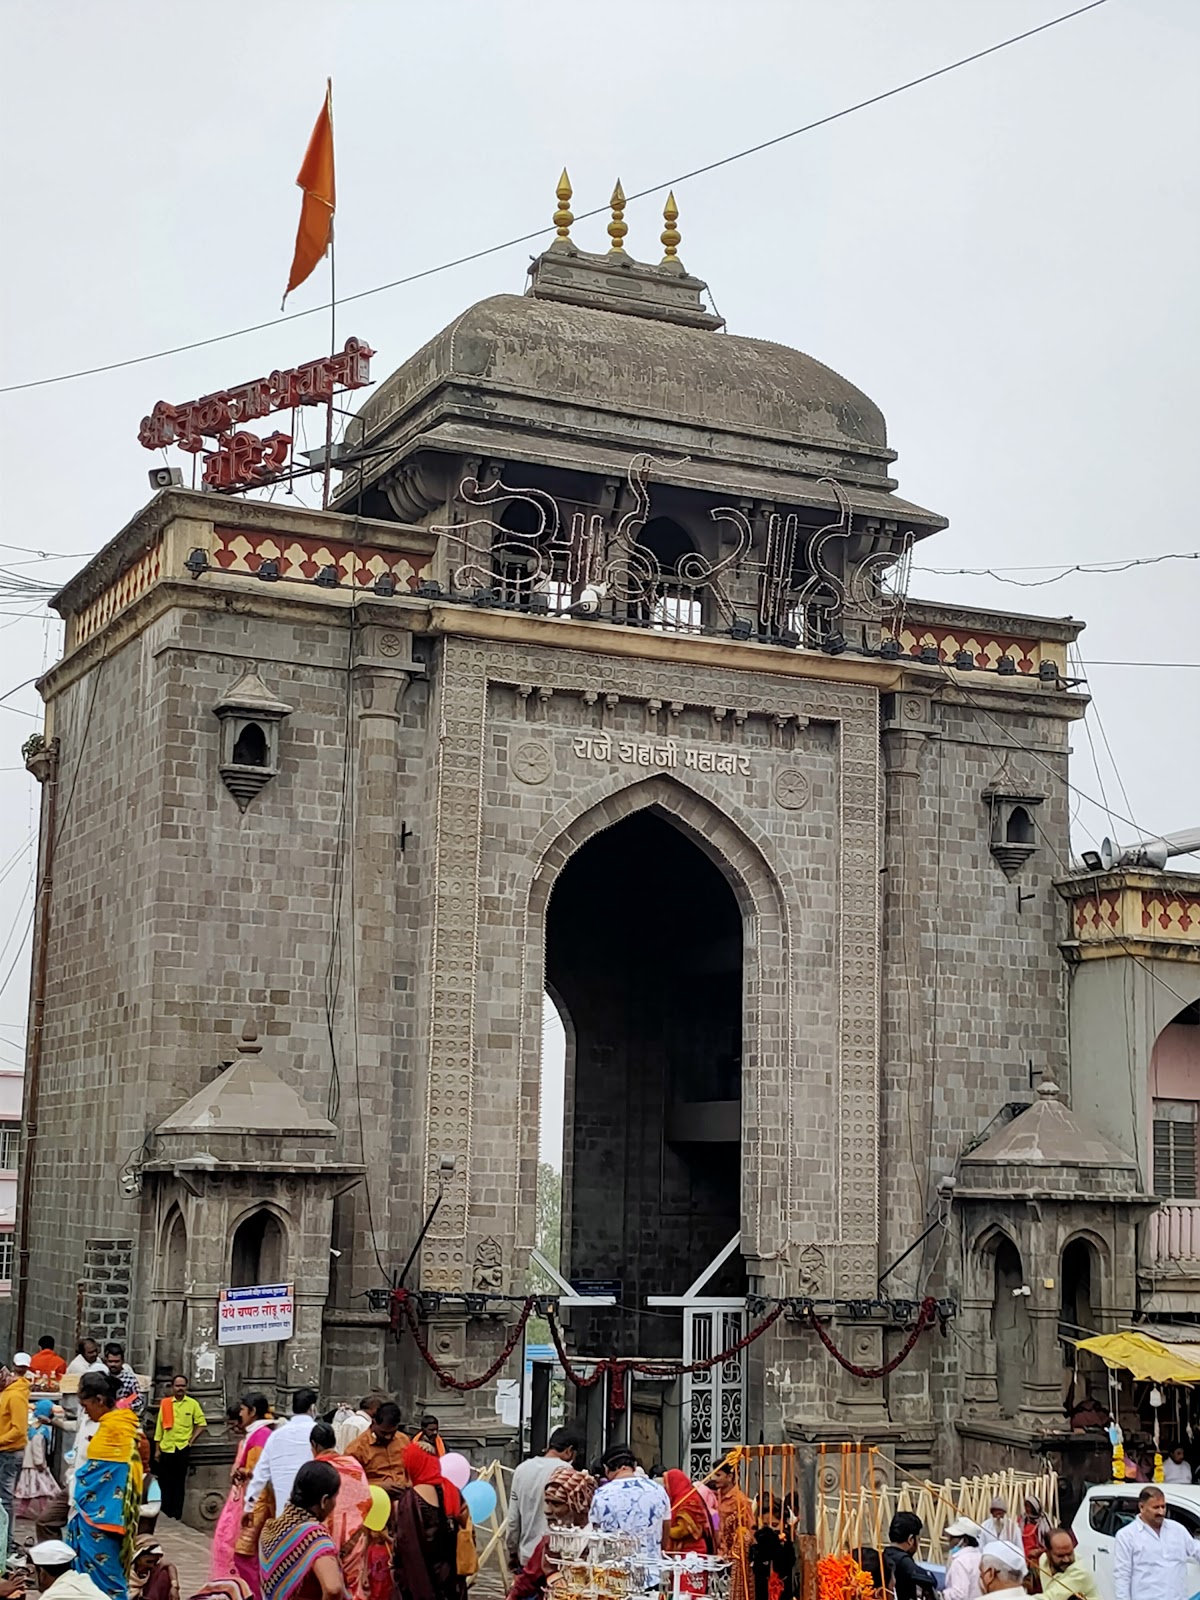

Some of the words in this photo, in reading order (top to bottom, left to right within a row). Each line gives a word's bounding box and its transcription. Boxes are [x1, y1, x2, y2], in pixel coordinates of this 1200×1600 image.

[202, 430, 293, 487] मंदिर
[574, 732, 613, 761] राजे
[618, 740, 679, 768] शहाजी
[685, 748, 752, 776] महाद्वार
